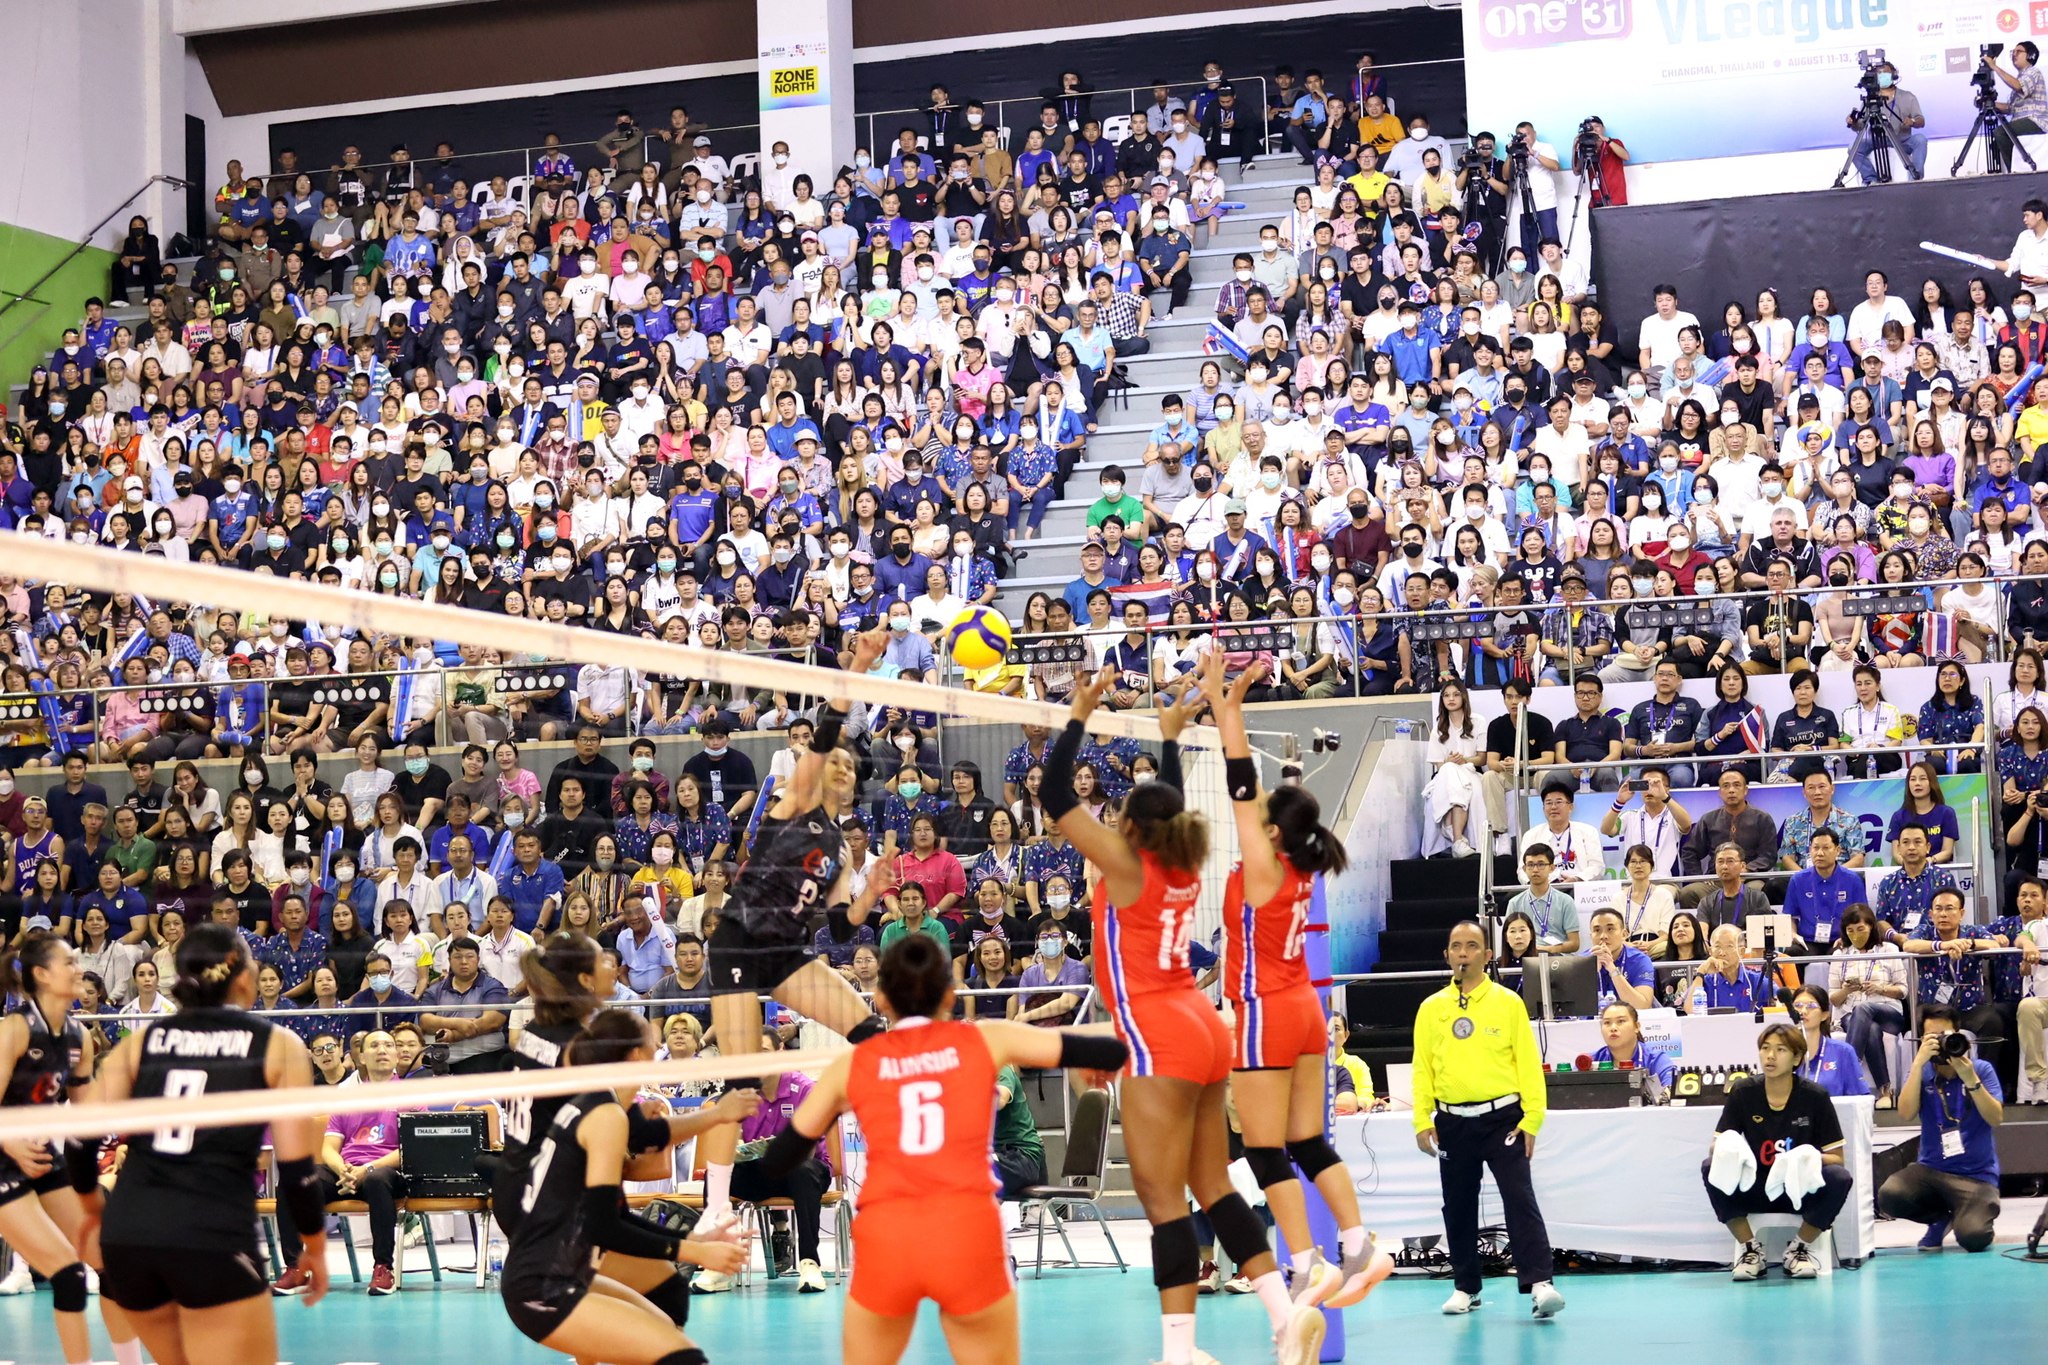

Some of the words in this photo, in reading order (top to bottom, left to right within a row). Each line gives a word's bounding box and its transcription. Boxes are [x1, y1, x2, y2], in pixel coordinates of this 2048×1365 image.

[1485, 0, 1567, 38] one
[1585, 0, 1622, 29] 31
[774, 69, 814, 83] ZONE
[1661, 66, 1717, 78] CHIANGMAI,
[1720, 60, 1765, 73] THAILAND
[1788, 55, 1824, 67] AUGUST
[1826, 53, 1852, 64] 11-13,
[774, 81, 815, 94] NORTH
[1788, 732, 1824, 745] THAILAND
[1581, 896, 1597, 904] AVC
[1597, 895, 1612, 903] SAV
[1158, 906, 1194, 970] 14
[147, 1027, 253, 1058] G.PORNPUN
[1643, 1033, 1671, 1042] ontrol
[878, 1047, 960, 1080] ALINSUG
[1678, 1073, 1699, 1095] 6
[899, 1080, 945, 1156] 6
[1760, 1136, 1793, 1166] est
